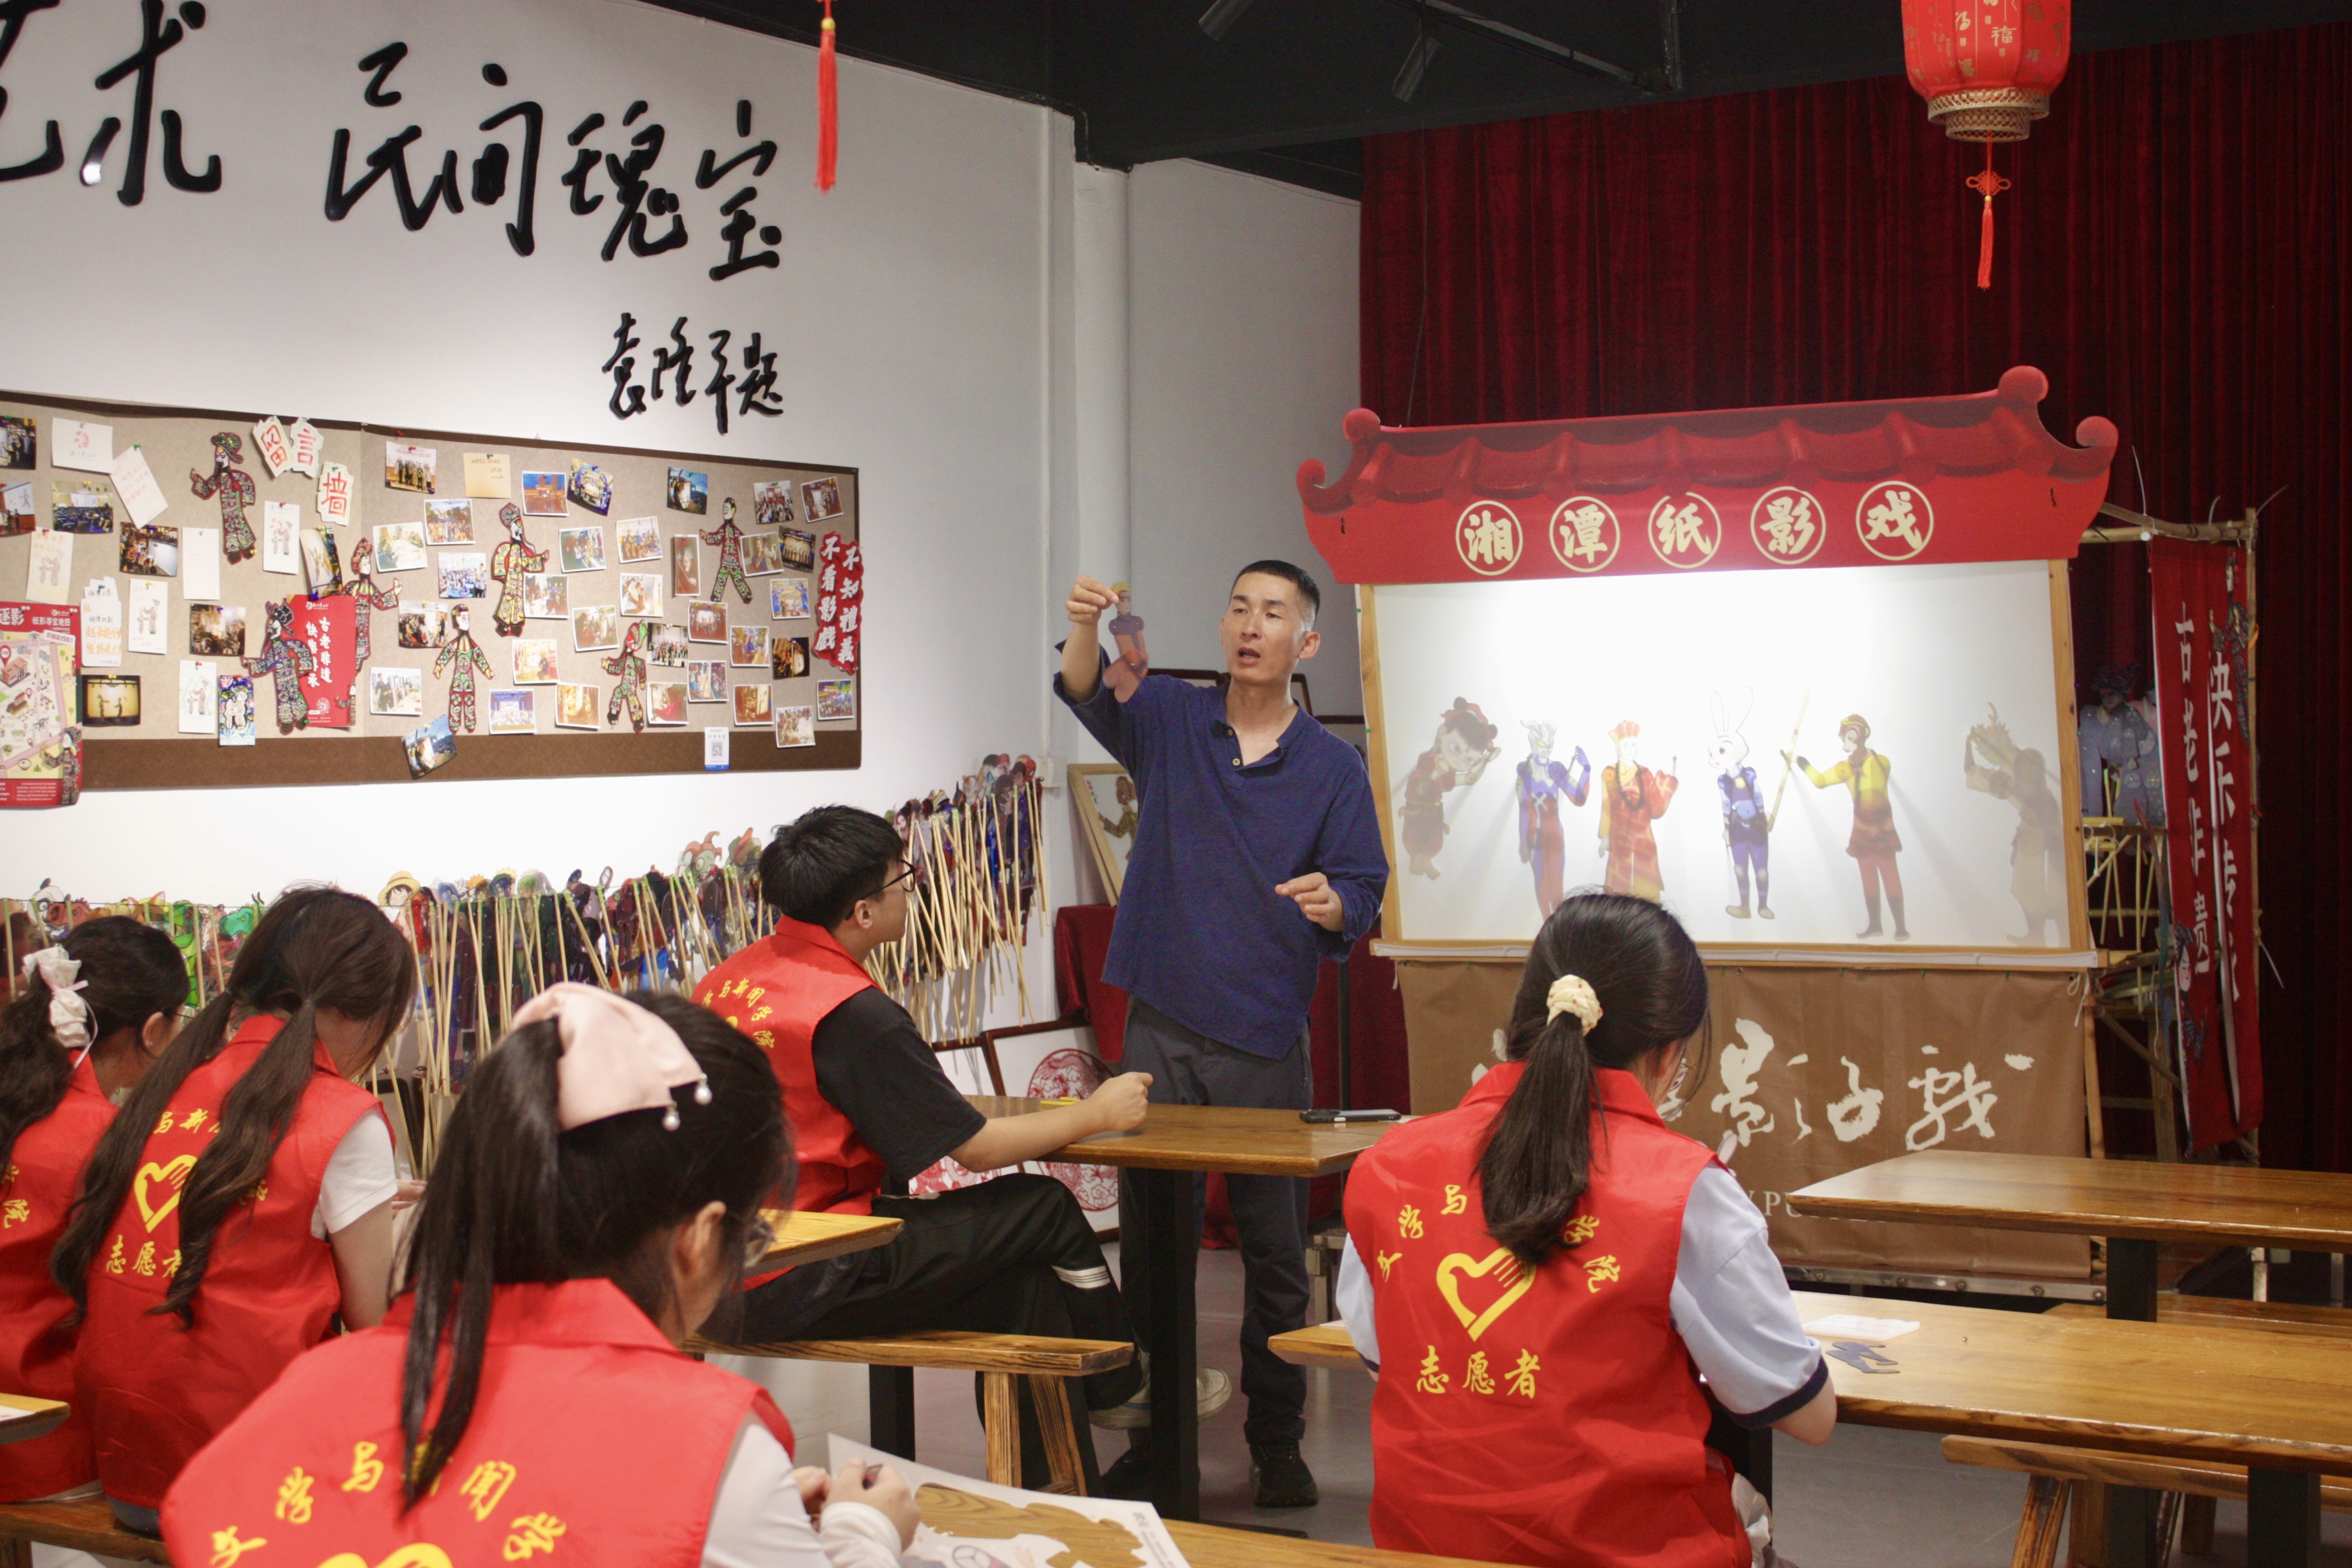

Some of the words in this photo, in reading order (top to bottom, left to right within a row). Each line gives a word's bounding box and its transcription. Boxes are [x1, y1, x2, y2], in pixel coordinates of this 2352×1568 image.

[1991, 25, 2017, 47] 福
[324, 41, 782, 281] 民间瑰宝
[1464, 490, 1923, 565] 湘潭纸影戏
[814, 536, 840, 651] 不看影戲
[837, 546, 859, 664] 不知禮義
[319, 616, 333, 684] 古老非遗
[1377, 1184, 1621, 1293] 文学与学院
[1416, 1344, 1540, 1400] 志愿者
[211, 1441, 567, 1568] 文学与闻学
